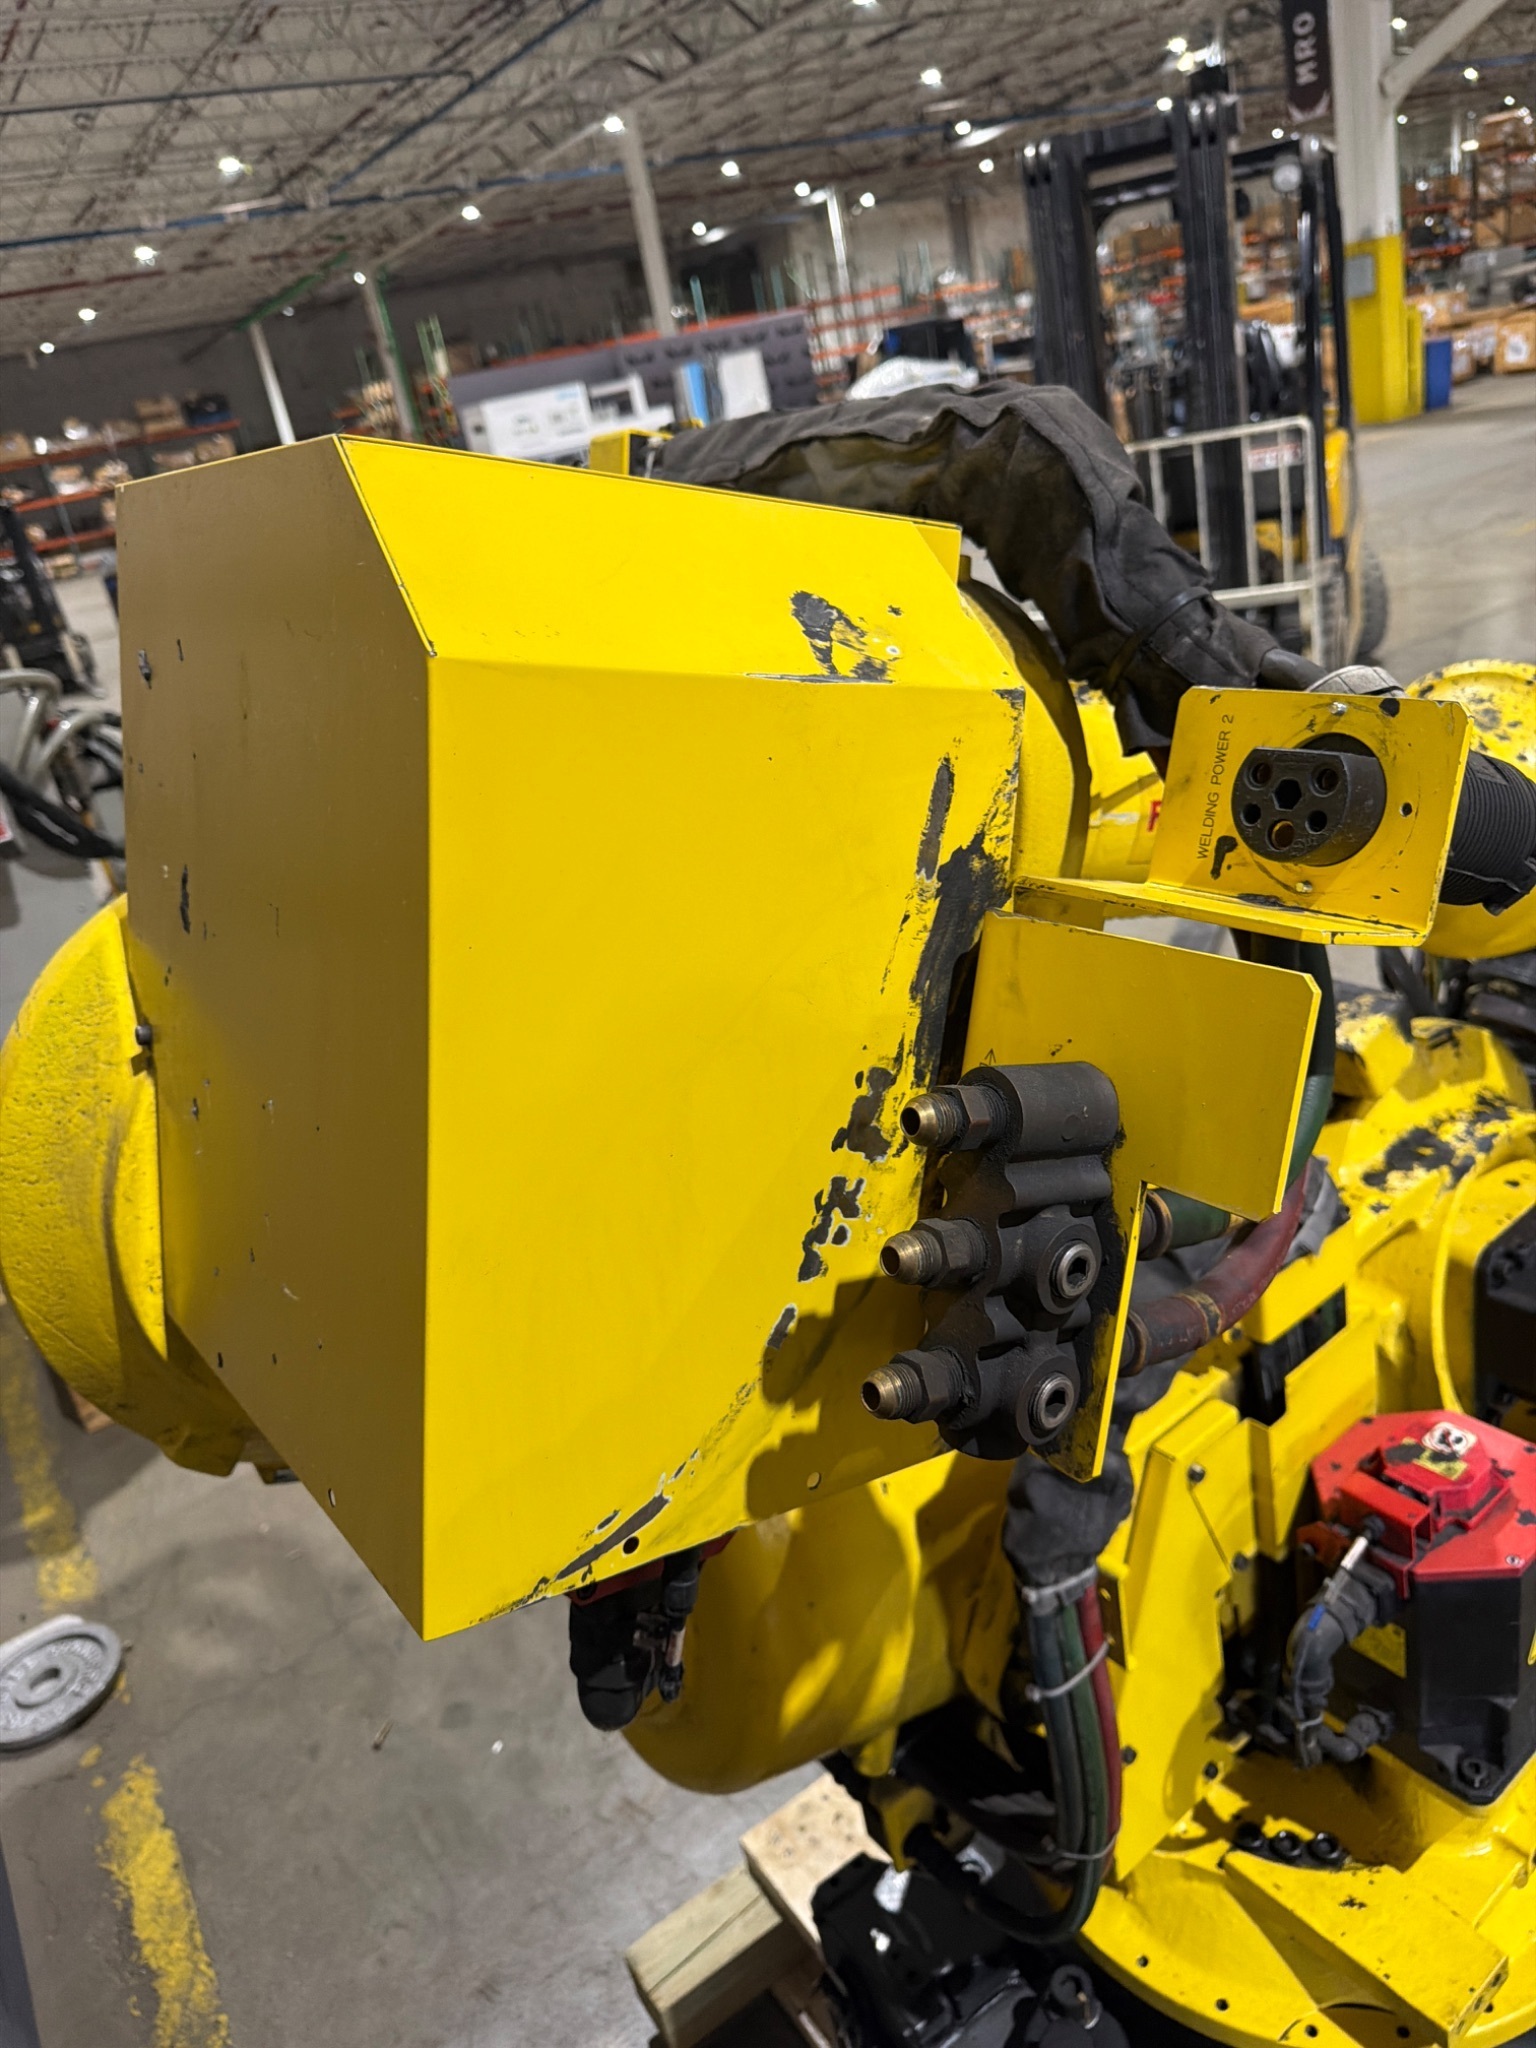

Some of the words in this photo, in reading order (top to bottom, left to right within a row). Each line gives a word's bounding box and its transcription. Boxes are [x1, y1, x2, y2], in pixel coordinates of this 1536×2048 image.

[1197, 792, 1220, 859] WELDING
[1210, 730, 1231, 786] POWER
[1221, 714, 1235, 724] 2
